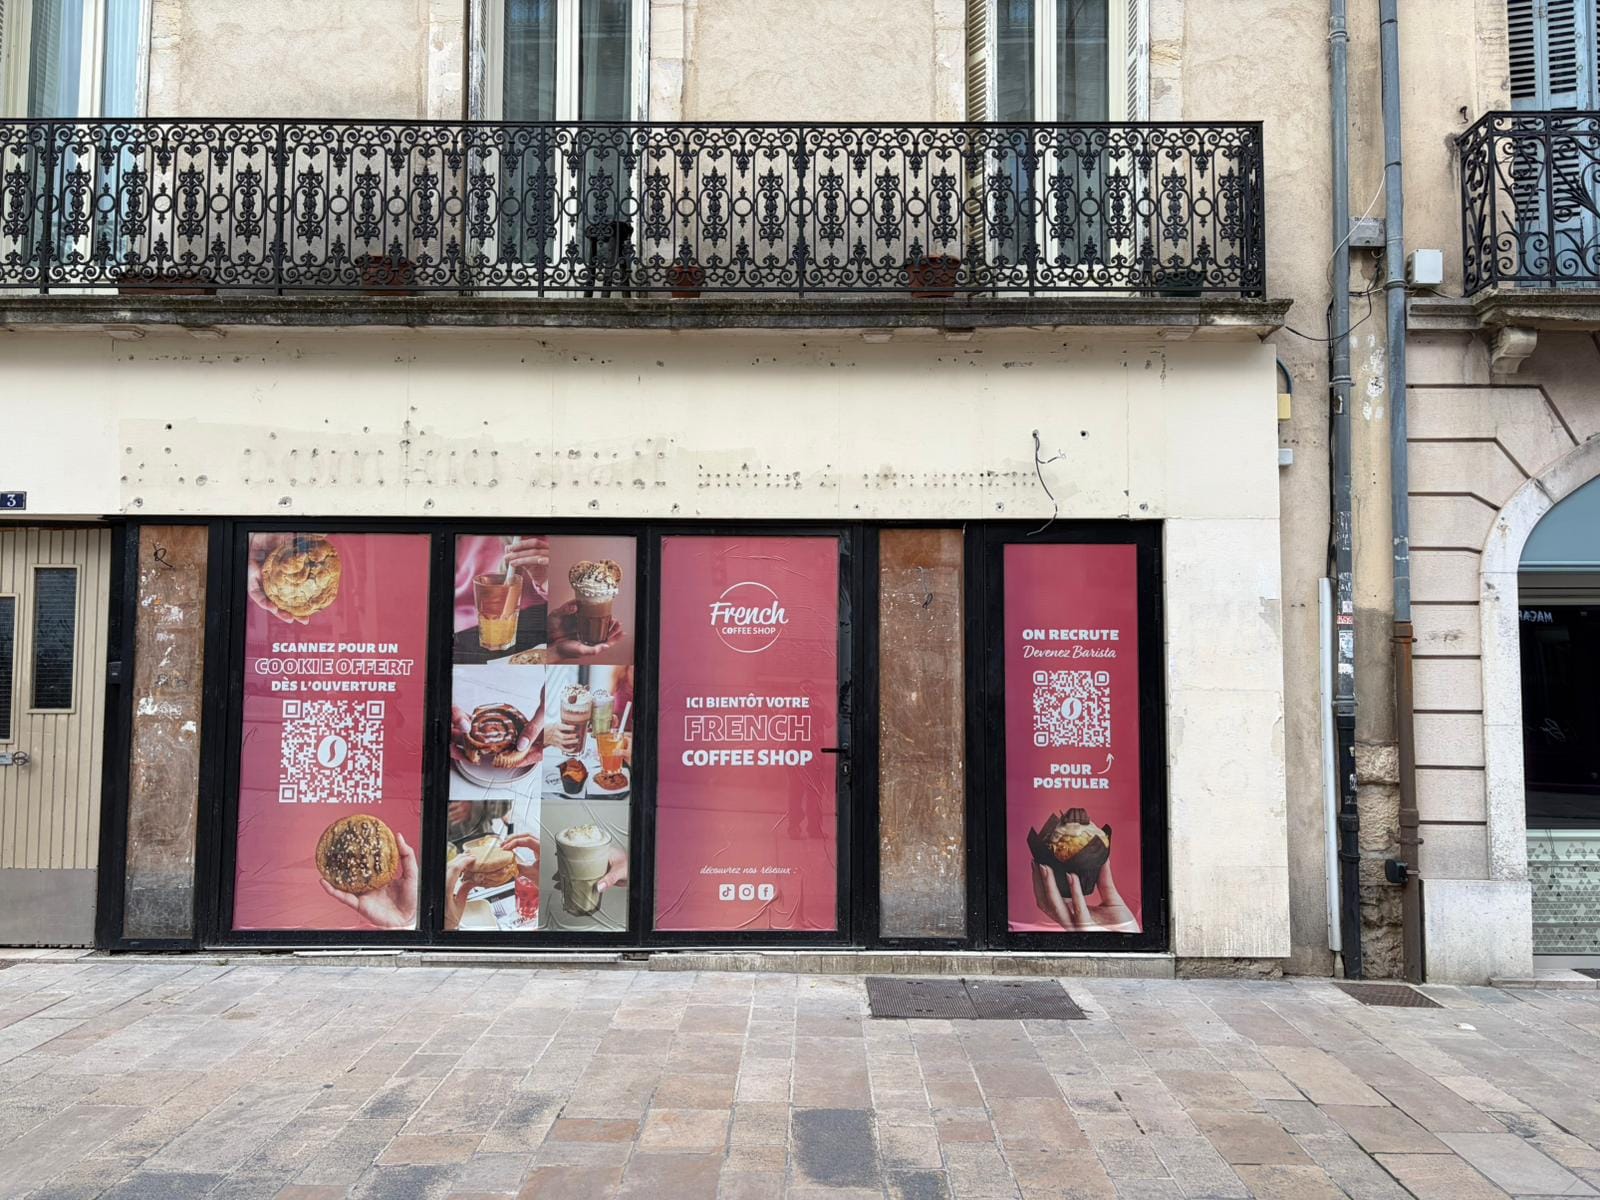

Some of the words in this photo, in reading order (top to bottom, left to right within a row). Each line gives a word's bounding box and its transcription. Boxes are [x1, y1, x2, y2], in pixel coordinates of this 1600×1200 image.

[7, 494, 16, 507] 3
[709, 600, 789, 626] French
[721, 627, 752, 635] COFFEE
[752, 627, 776, 635] SHOP
[1022, 629, 1046, 641] ON
[1049, 629, 1119, 641] RECRUTE
[272, 642, 335, 653] SCANNEZ
[338, 643, 376, 653] POUR
[378, 643, 398, 653] UN
[1022, 645, 1070, 659] Devenez
[1072, 645, 1117, 659] Barista
[255, 658, 333, 675] COOKIE
[336, 658, 414, 676] OFFERT
[271, 676, 298, 692] DÈS
[300, 680, 397, 692] L'OUVERTURE
[686, 697, 704, 708] ICI
[706, 692, 764, 708] BIENTÔT
[765, 697, 810, 708] VOTRE
[684, 715, 811, 742] FRENCH
[682, 749, 755, 766] COFFEE
[757, 749, 813, 766] SHOP
[1050, 763, 1092, 775] POUR
[1033, 777, 1109, 789] POSTULER
[699, 865, 741, 874] découvrez
[760, 866, 790, 875] réseaux
